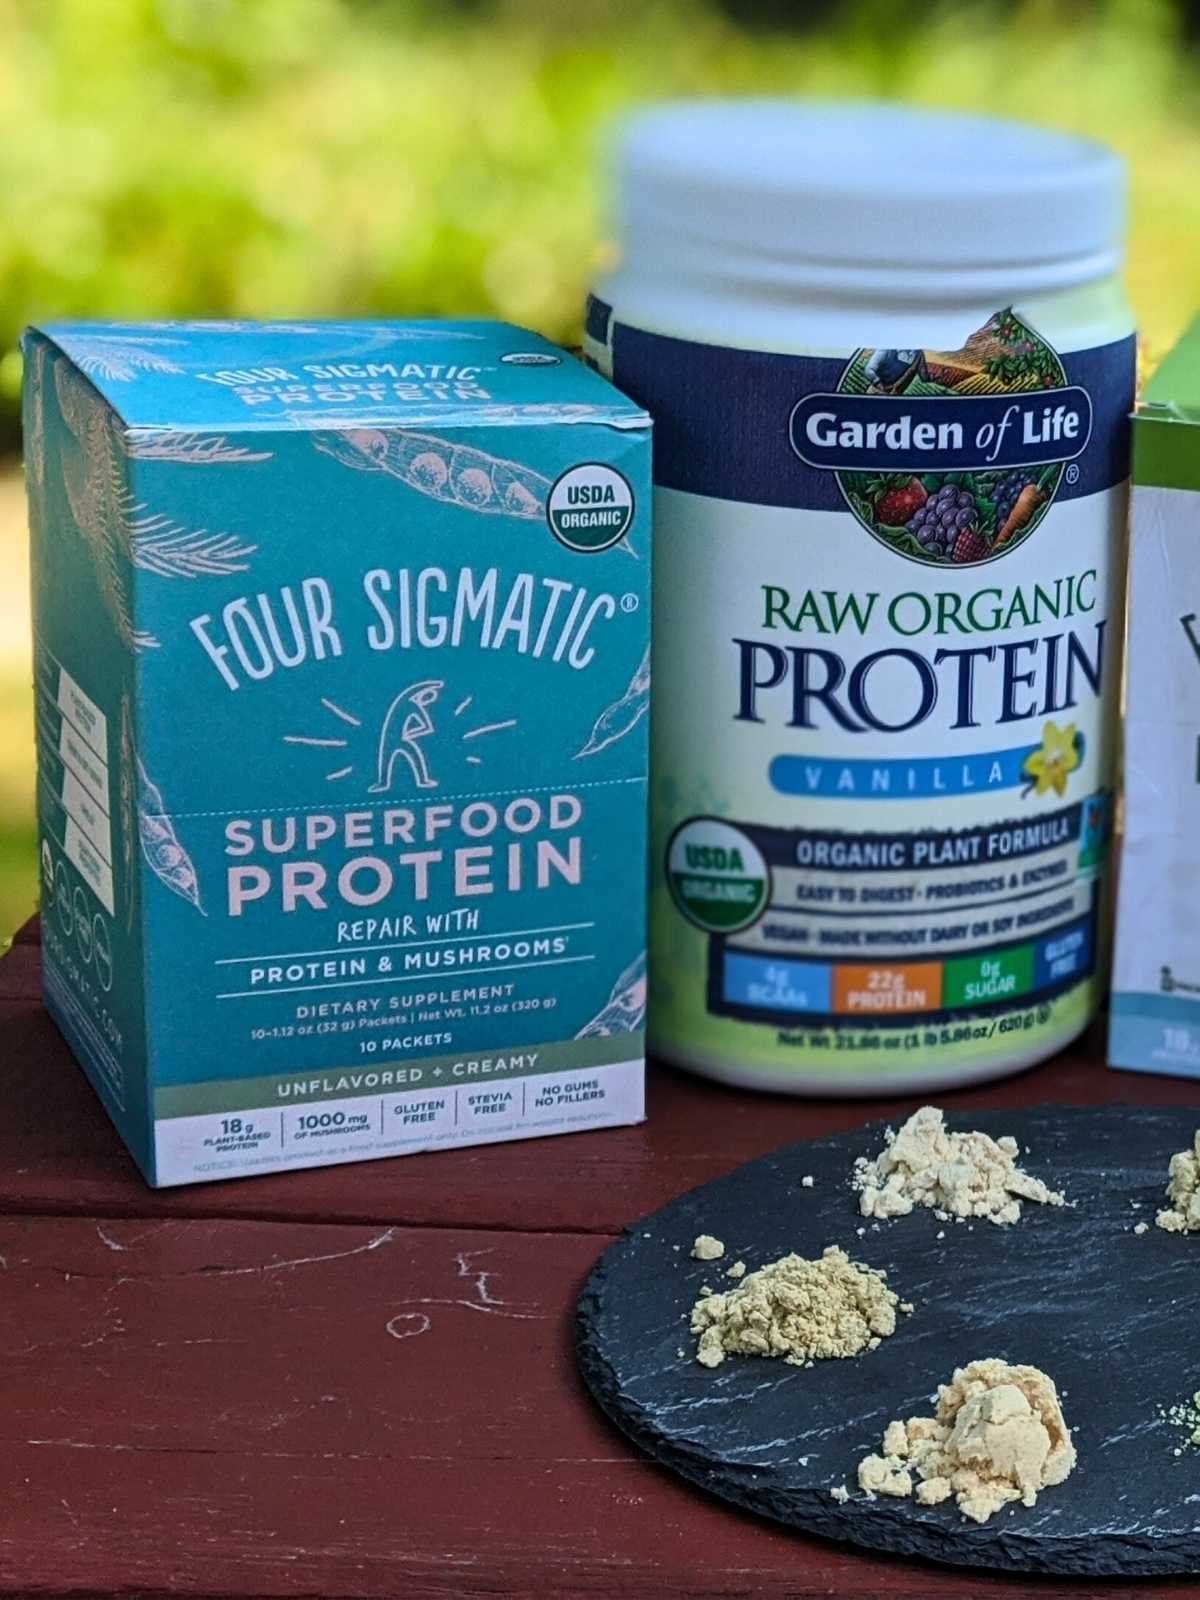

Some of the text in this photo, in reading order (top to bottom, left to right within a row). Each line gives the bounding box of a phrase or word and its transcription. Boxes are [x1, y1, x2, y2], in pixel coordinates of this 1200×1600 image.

[196, 363, 482, 387] FOUR SIGMATIC
[241, 388, 492, 405] PROTEIN
[805, 405, 1079, 463] Garden of Life
[567, 484, 616, 506] USDA
[561, 508, 622, 531] ORGANIC
[760, 569, 1098, 638] RAW ORGANIC
[189, 567, 616, 691] FOUR SIGMATIC
[731, 617, 1109, 736] PROTEIN
[805, 760, 1004, 792] VANILLA
[223, 793, 584, 858] SUPERFOOD
[796, 821, 1070, 868] ORGANIC PLANT FORMULA
[684, 843, 745, 873] USDA
[227, 837, 584, 917] PROTEIN
[337, 907, 480, 943] REPAIR WITH
[251, 938, 566, 986] PROTEIN & MUSHROOMS
[964, 975, 1017, 1001] SUGAR
[296, 984, 516, 1020] DIETARY SUPPLEMENT
[358, 1012, 408, 1030] Packets
[359, 1031, 454, 1055] 10 PACKETS
[277, 1053, 540, 1097] UNFLAVORED CREAMY
[542, 1079, 600, 1096] NO GUMS
[393, 1099, 445, 1116] GLUTEN
[467, 1090, 513, 1106] STEVIA
[473, 1102, 507, 1116] FREE
[535, 1090, 607, 1108] NO FILLERS
[220, 1117, 243, 1136] 18
[297, 1111, 346, 1131] 1000
[402, 1111, 437, 1126] FREE
